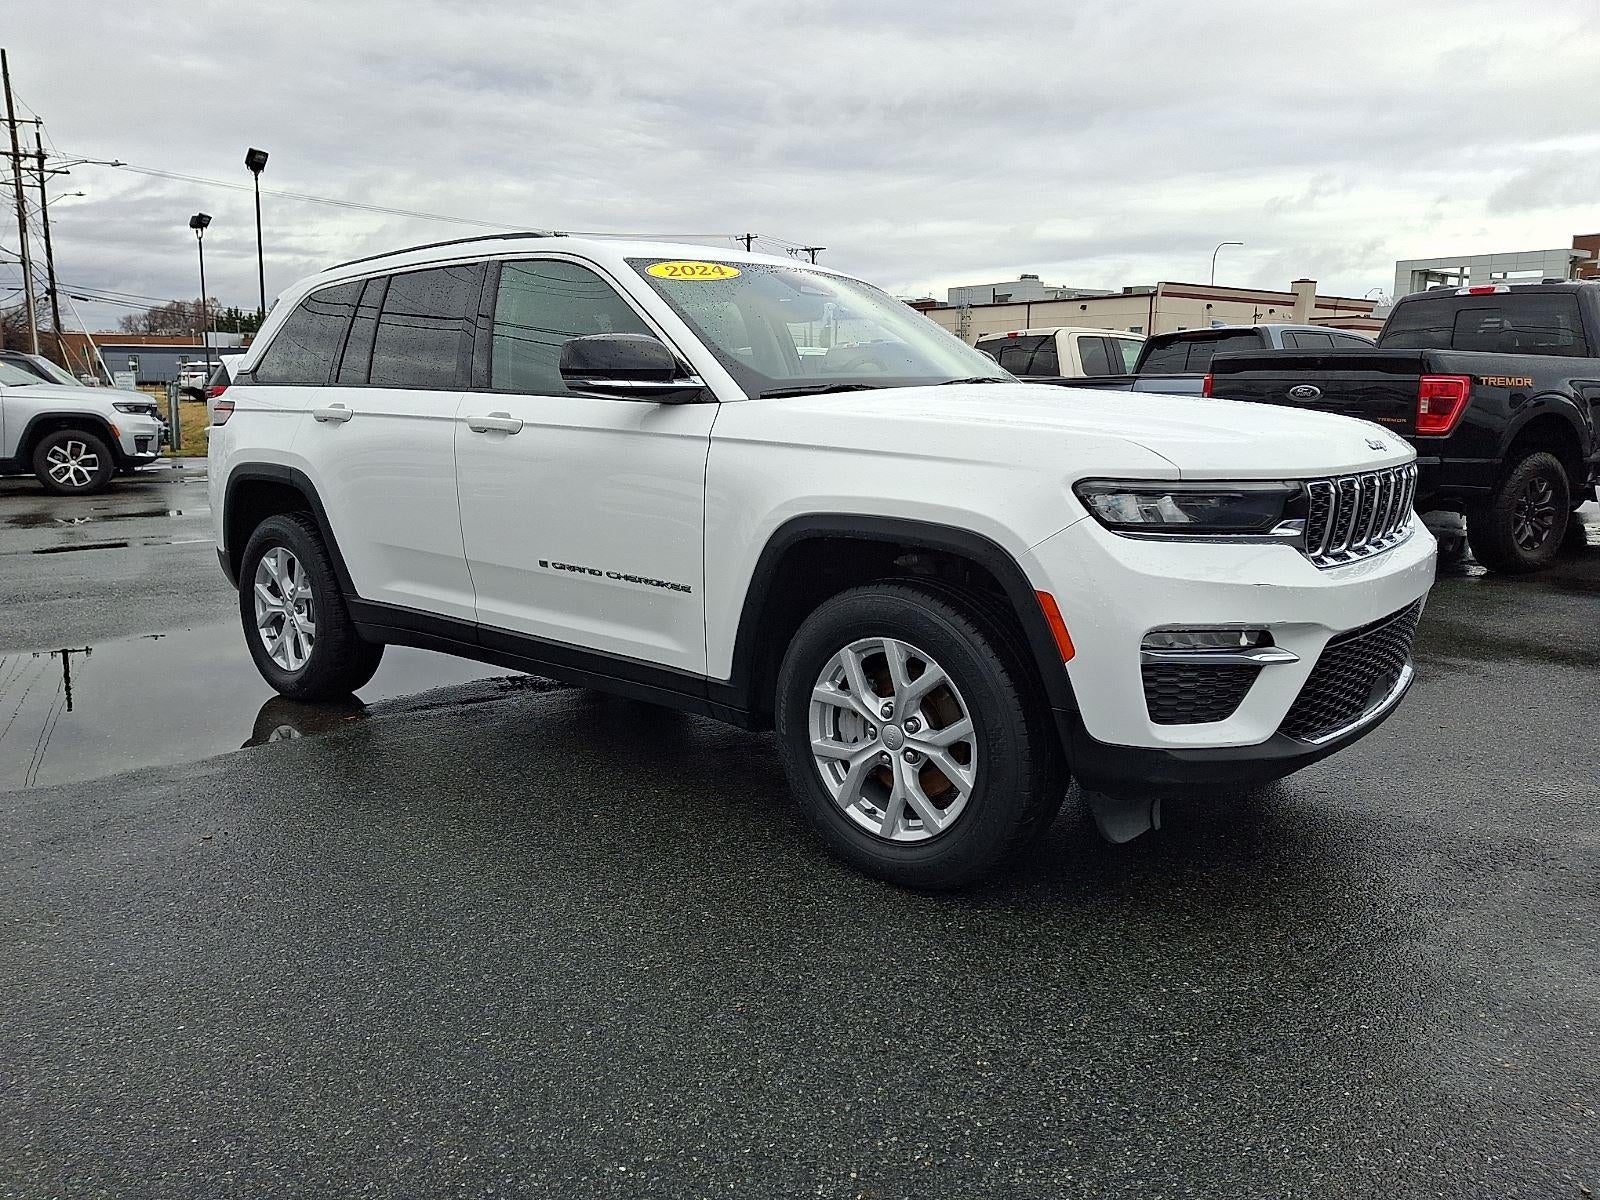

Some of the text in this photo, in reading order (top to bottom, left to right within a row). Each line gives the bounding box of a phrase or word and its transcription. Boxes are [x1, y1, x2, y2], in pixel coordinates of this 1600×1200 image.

[664, 265, 727, 277] 2024
[1479, 376, 1533, 387] TREMOR
[551, 561, 603, 577] GRAND
[605, 570, 692, 594] CHEROKEE
